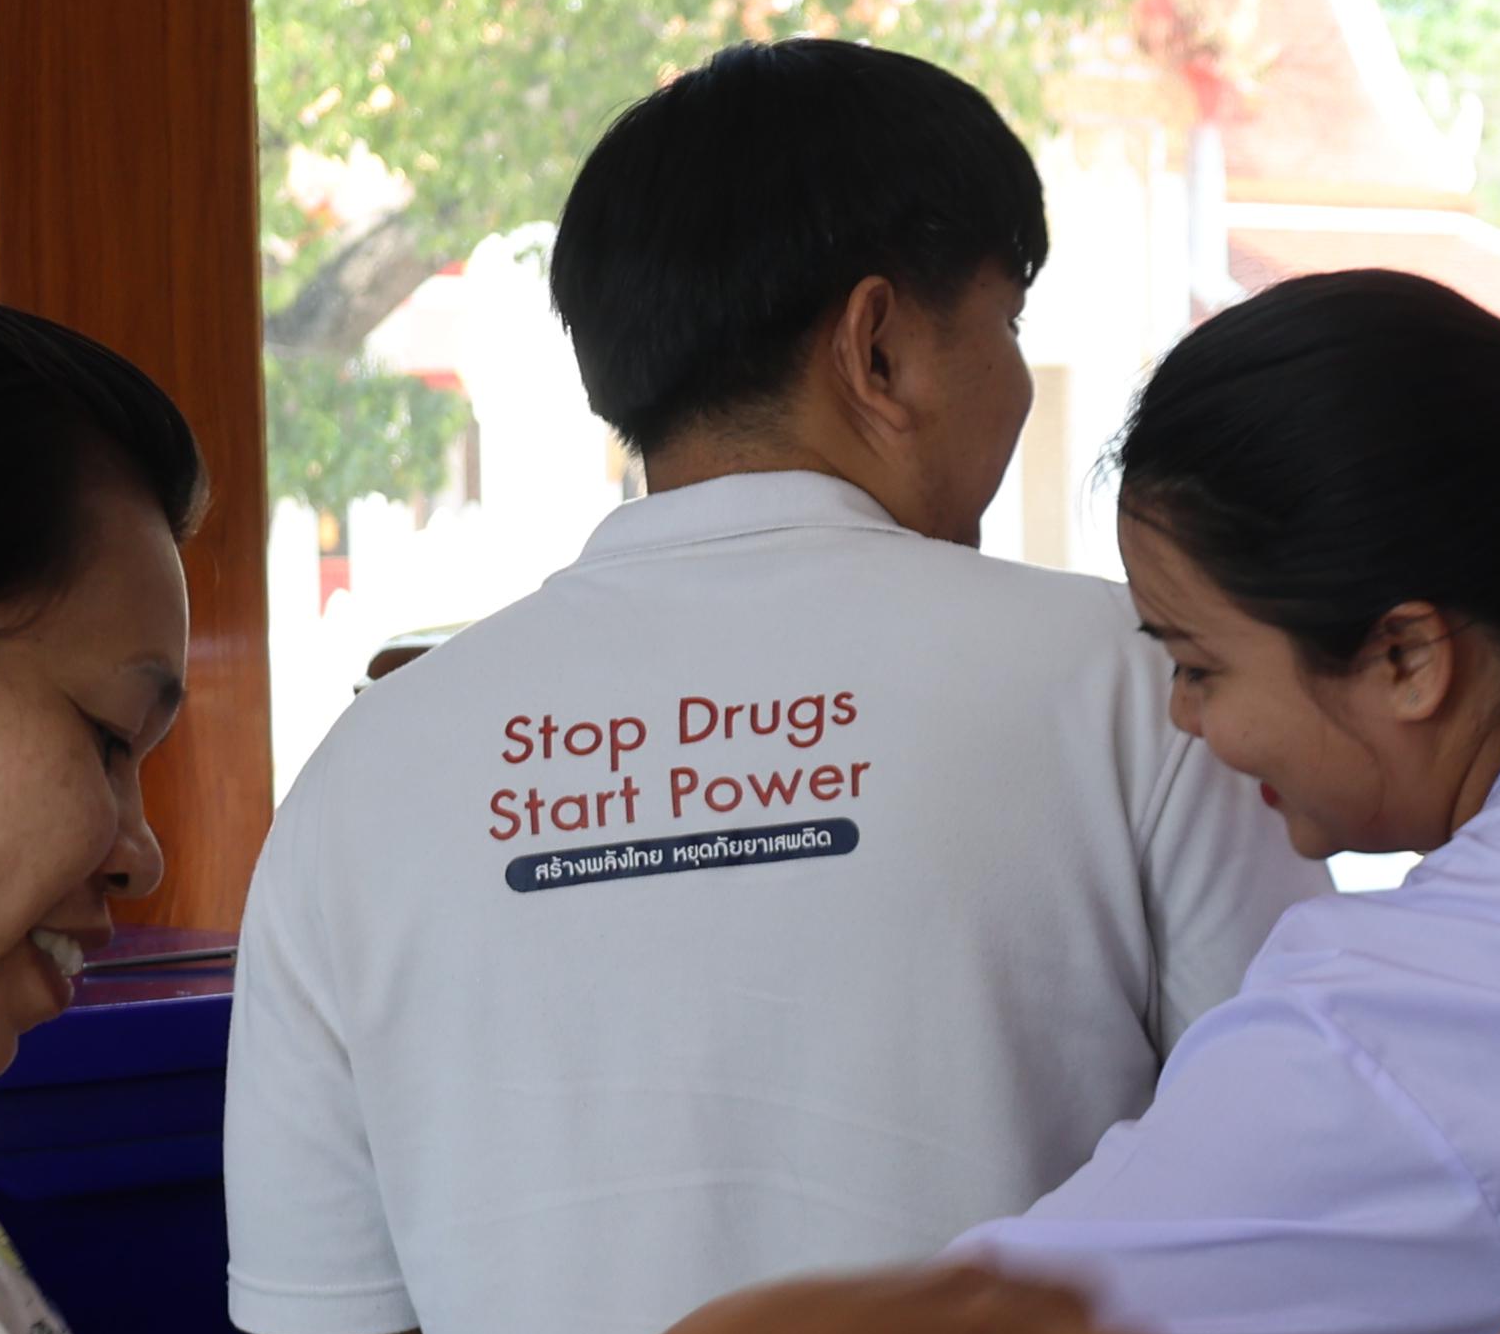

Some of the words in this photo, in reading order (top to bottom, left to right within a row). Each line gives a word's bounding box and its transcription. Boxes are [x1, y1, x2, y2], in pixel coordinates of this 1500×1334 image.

[501, 714, 647, 771] Stop
[679, 690, 857, 748] Drugs
[488, 775, 640, 841] Start
[670, 760, 871, 818] Power
[535, 846, 663, 881] สร้างพลังไทย
[673, 827, 832, 866] หยุดภัยยาเสพติด
